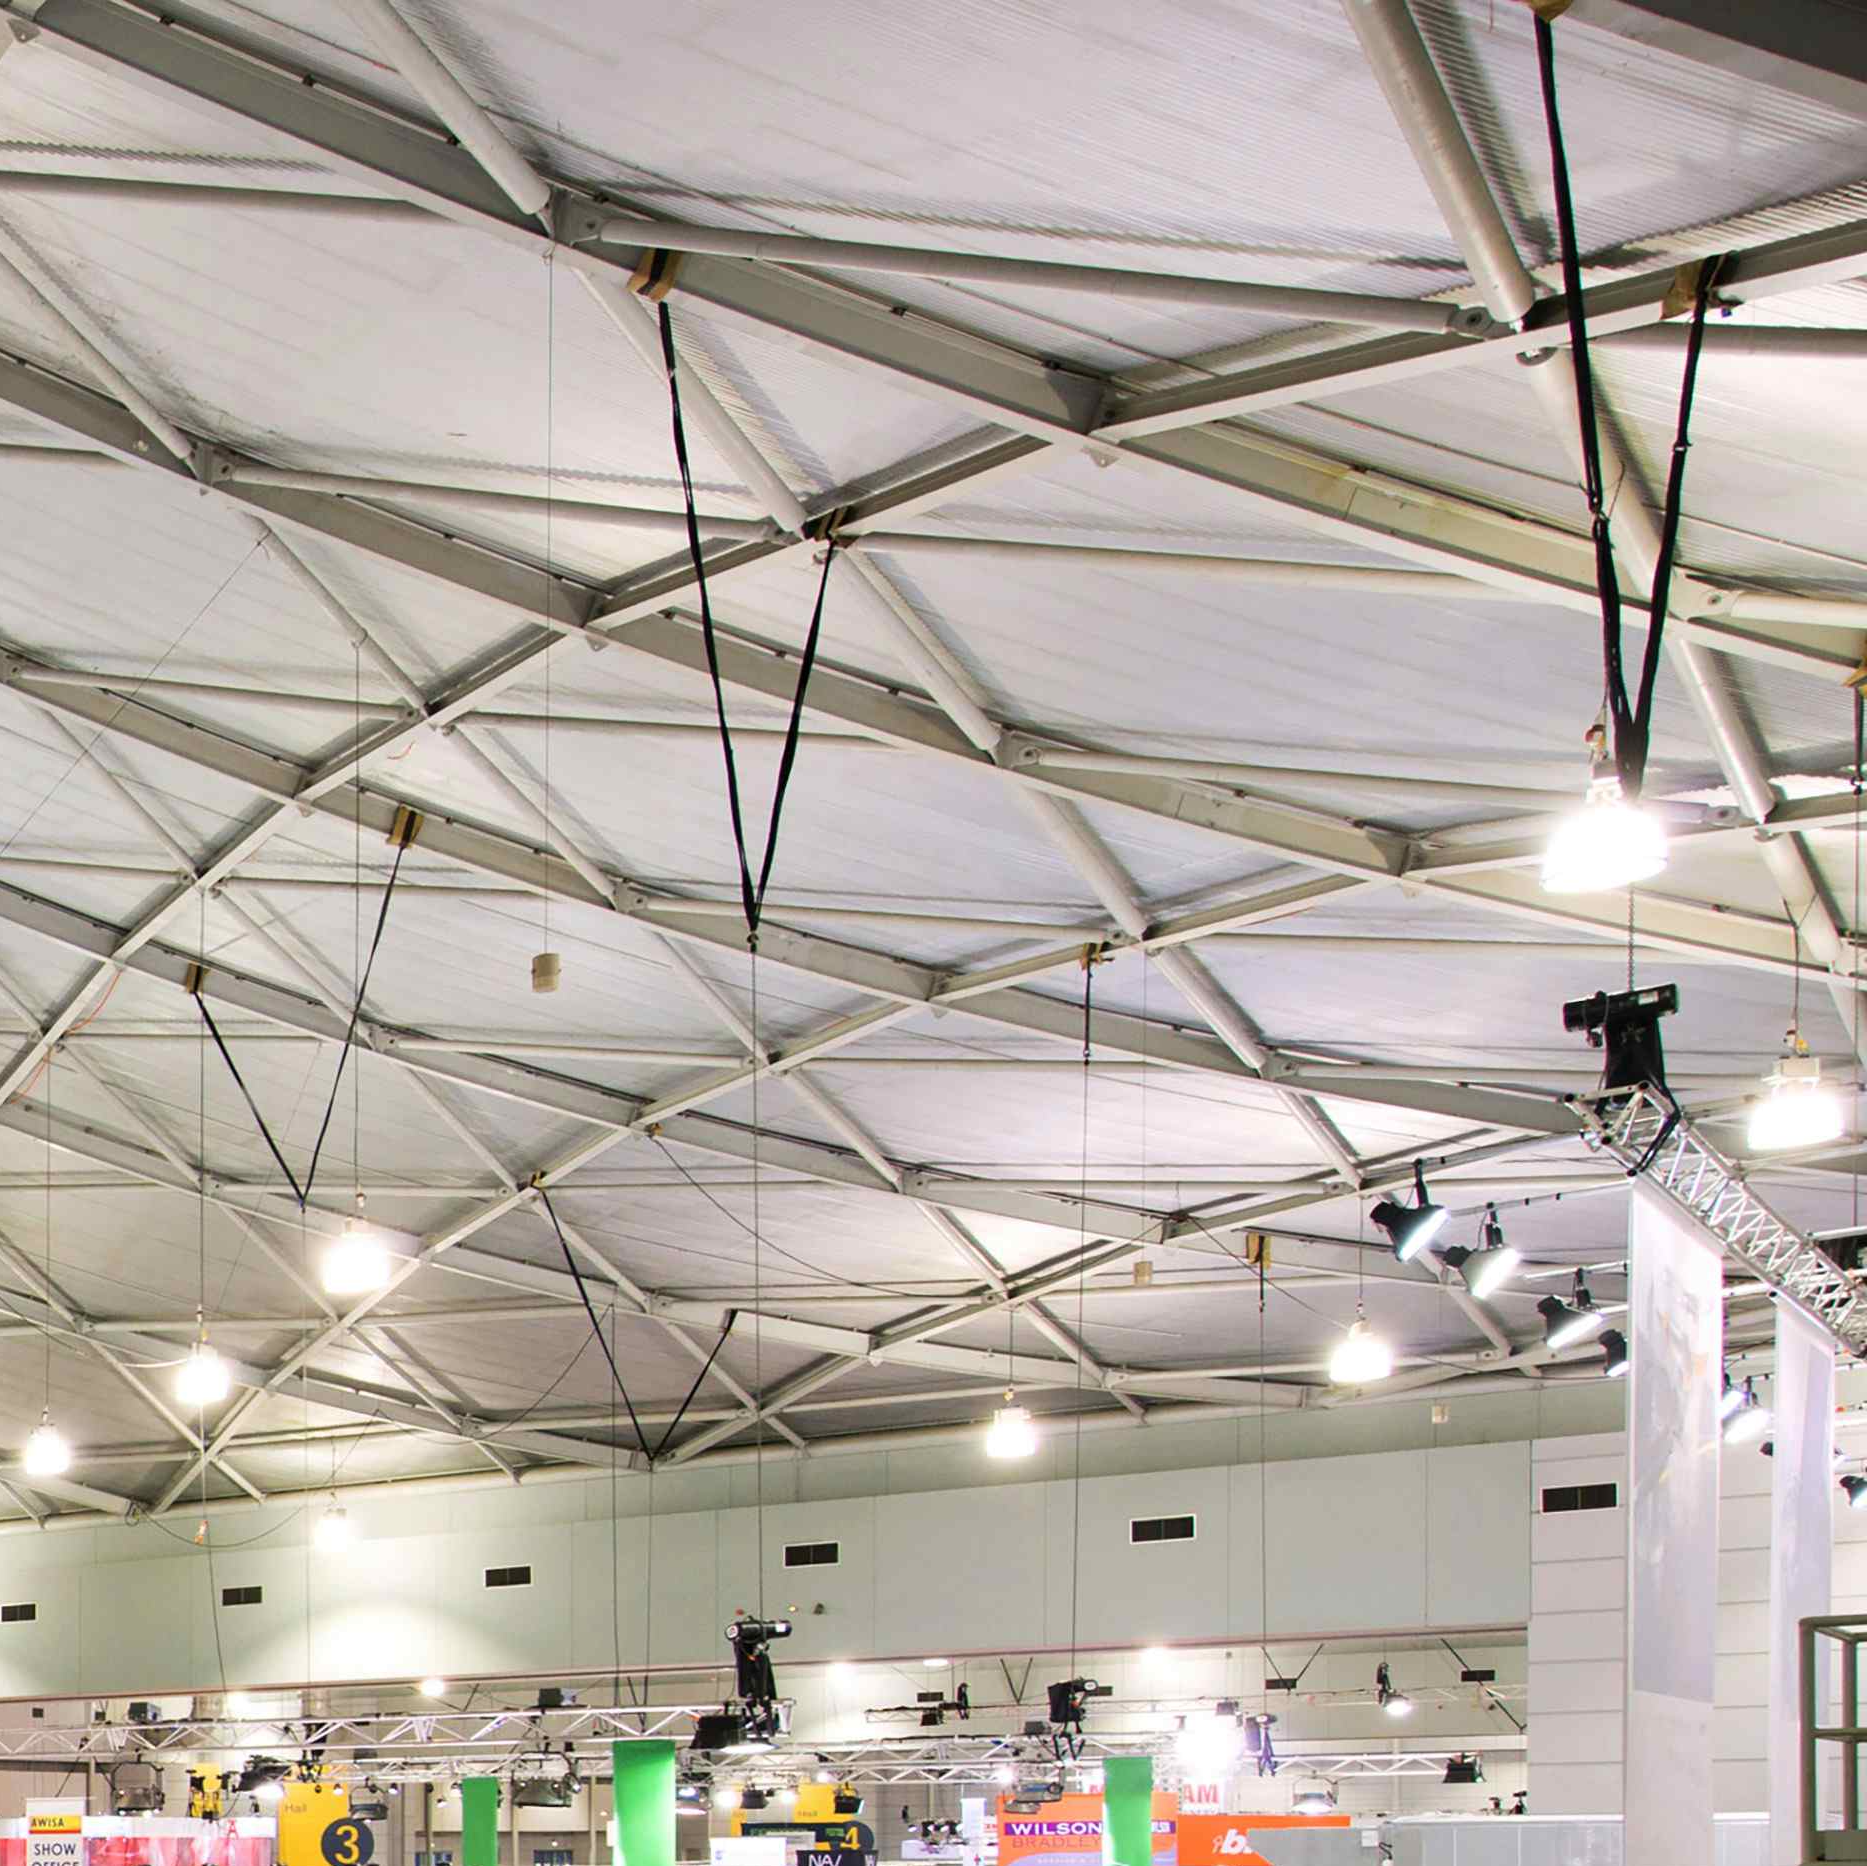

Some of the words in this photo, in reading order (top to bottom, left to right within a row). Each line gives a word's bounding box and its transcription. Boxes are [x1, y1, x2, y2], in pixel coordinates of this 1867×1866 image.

[284, 1802, 307, 1814] Hall
[31, 1817, 65, 1828] AWISA
[1012, 1823, 1103, 1835] WILSON
[334, 1823, 359, 1865] 3
[1011, 1835, 1102, 1849] BRADLEY
[34, 1843, 75, 1857] SHOW
